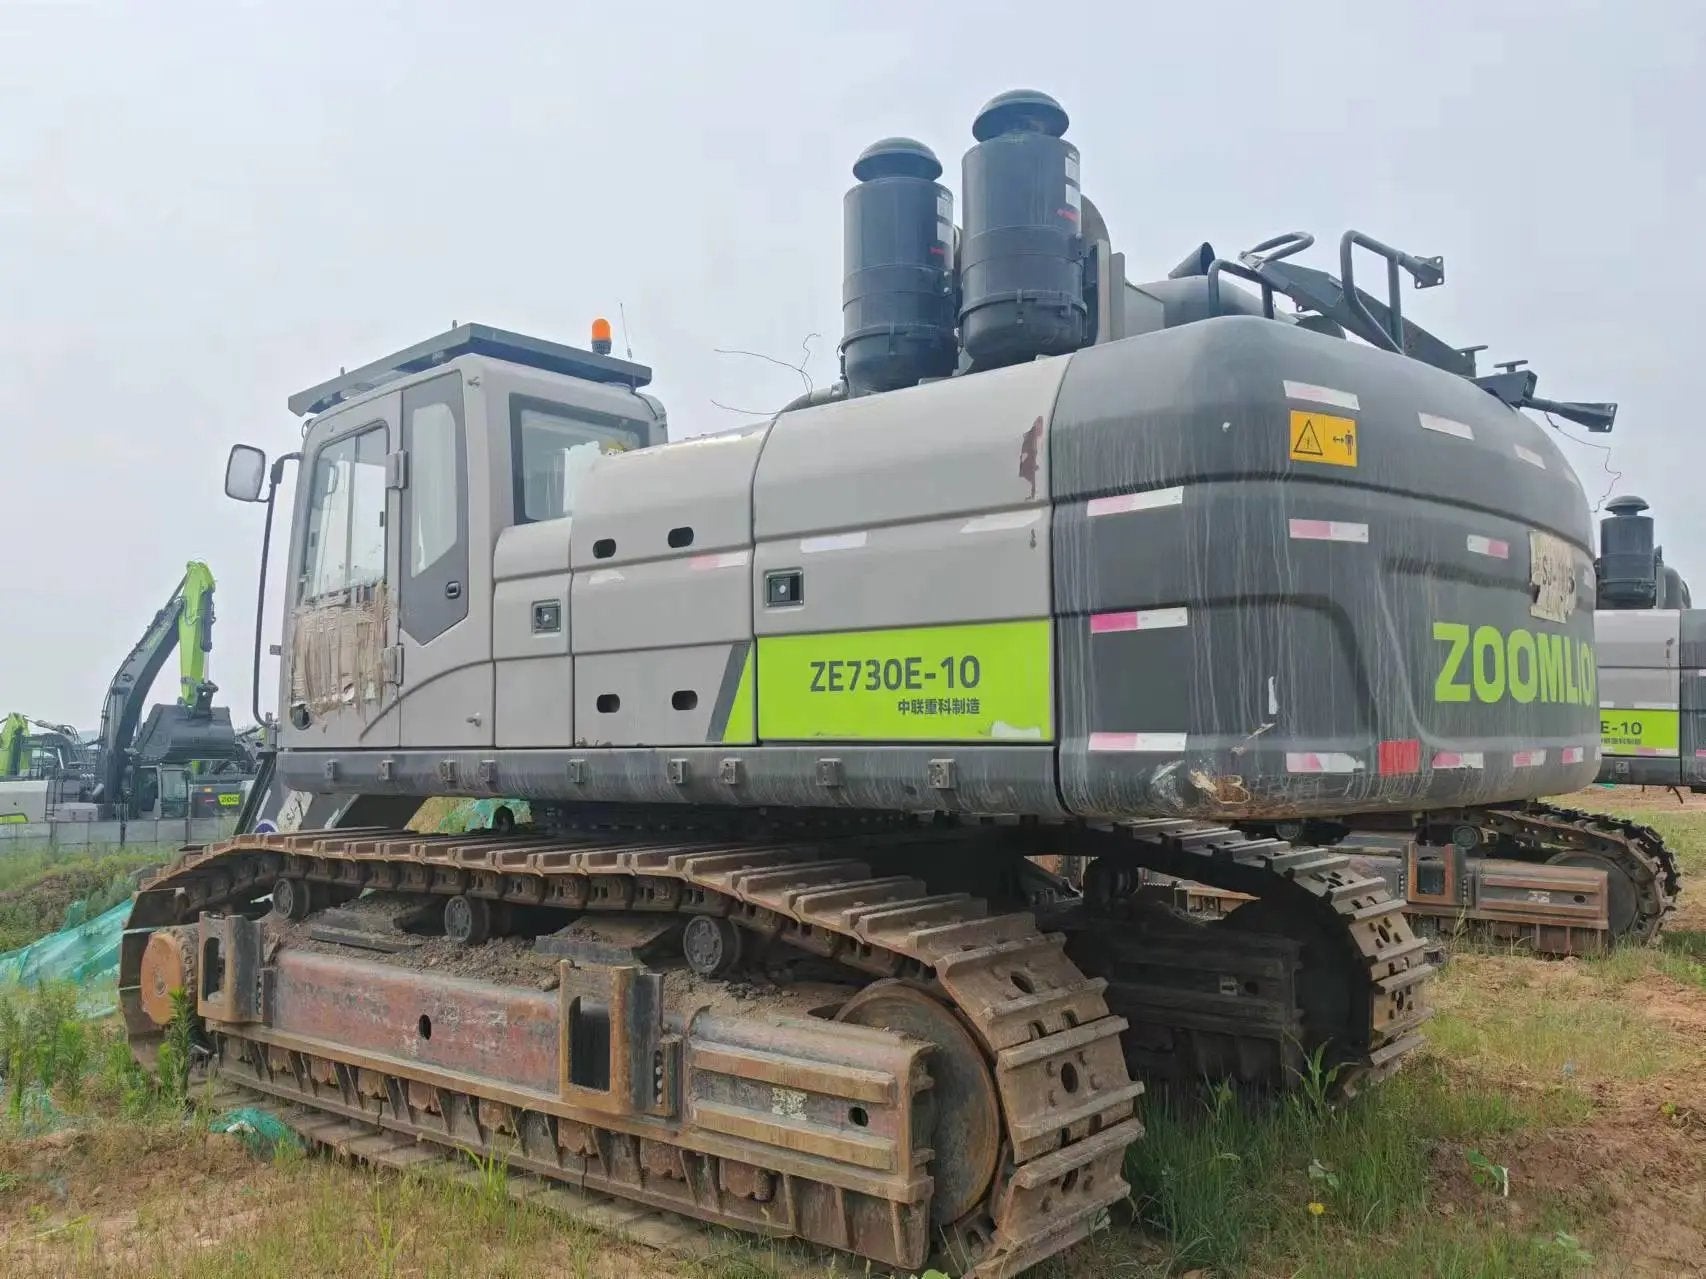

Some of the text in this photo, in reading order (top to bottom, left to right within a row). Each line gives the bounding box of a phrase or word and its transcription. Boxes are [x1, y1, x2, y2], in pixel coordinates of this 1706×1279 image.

[810, 655, 981, 692] ZE730E-10
[897, 698, 981, 716] 中联重科制造
